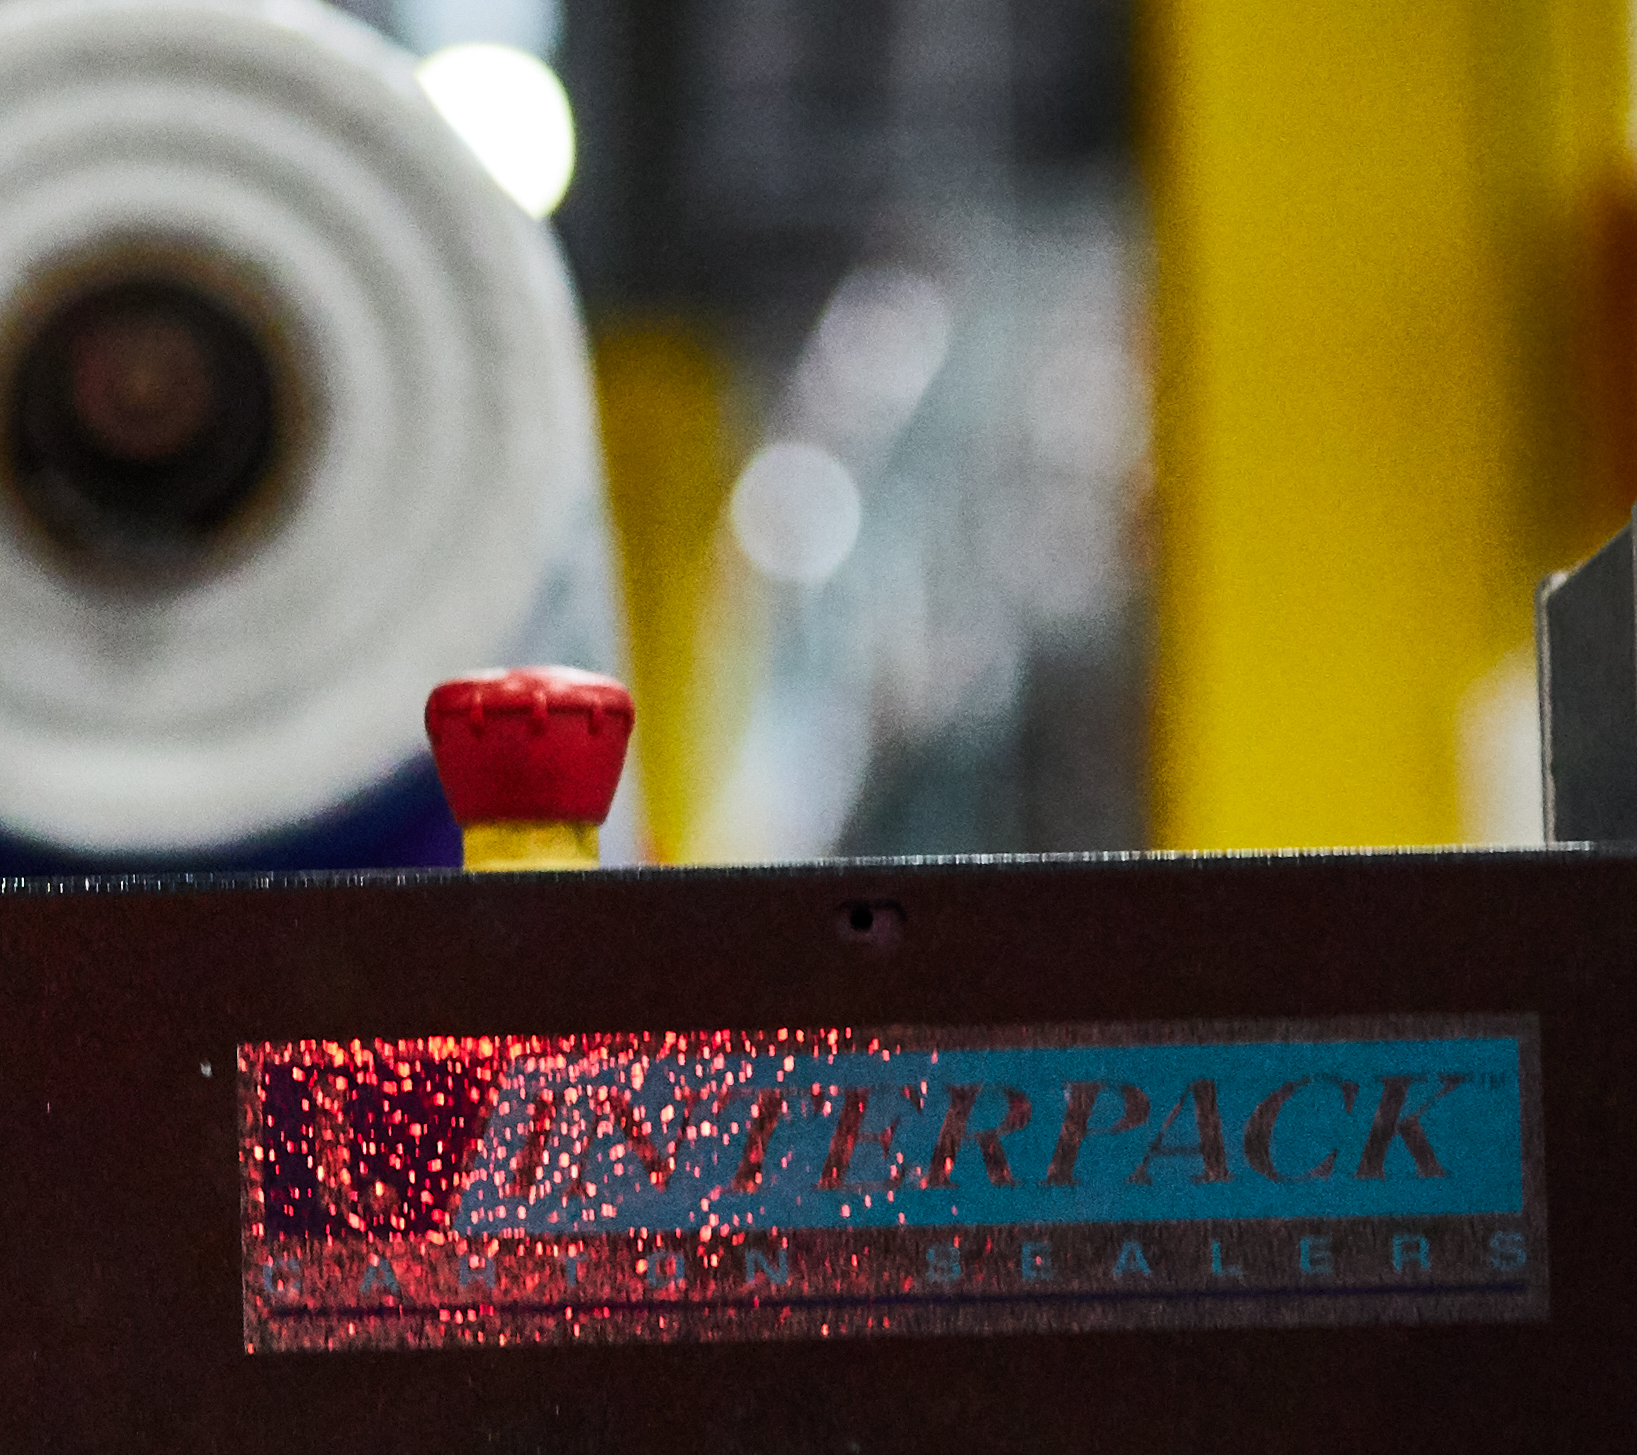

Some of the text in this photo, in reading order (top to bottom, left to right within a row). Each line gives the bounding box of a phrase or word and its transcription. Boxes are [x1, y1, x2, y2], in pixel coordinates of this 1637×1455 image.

[501, 1070, 1468, 1197] INTERPACK
[262, 1230, 1529, 1296] CARTON SEALERS
